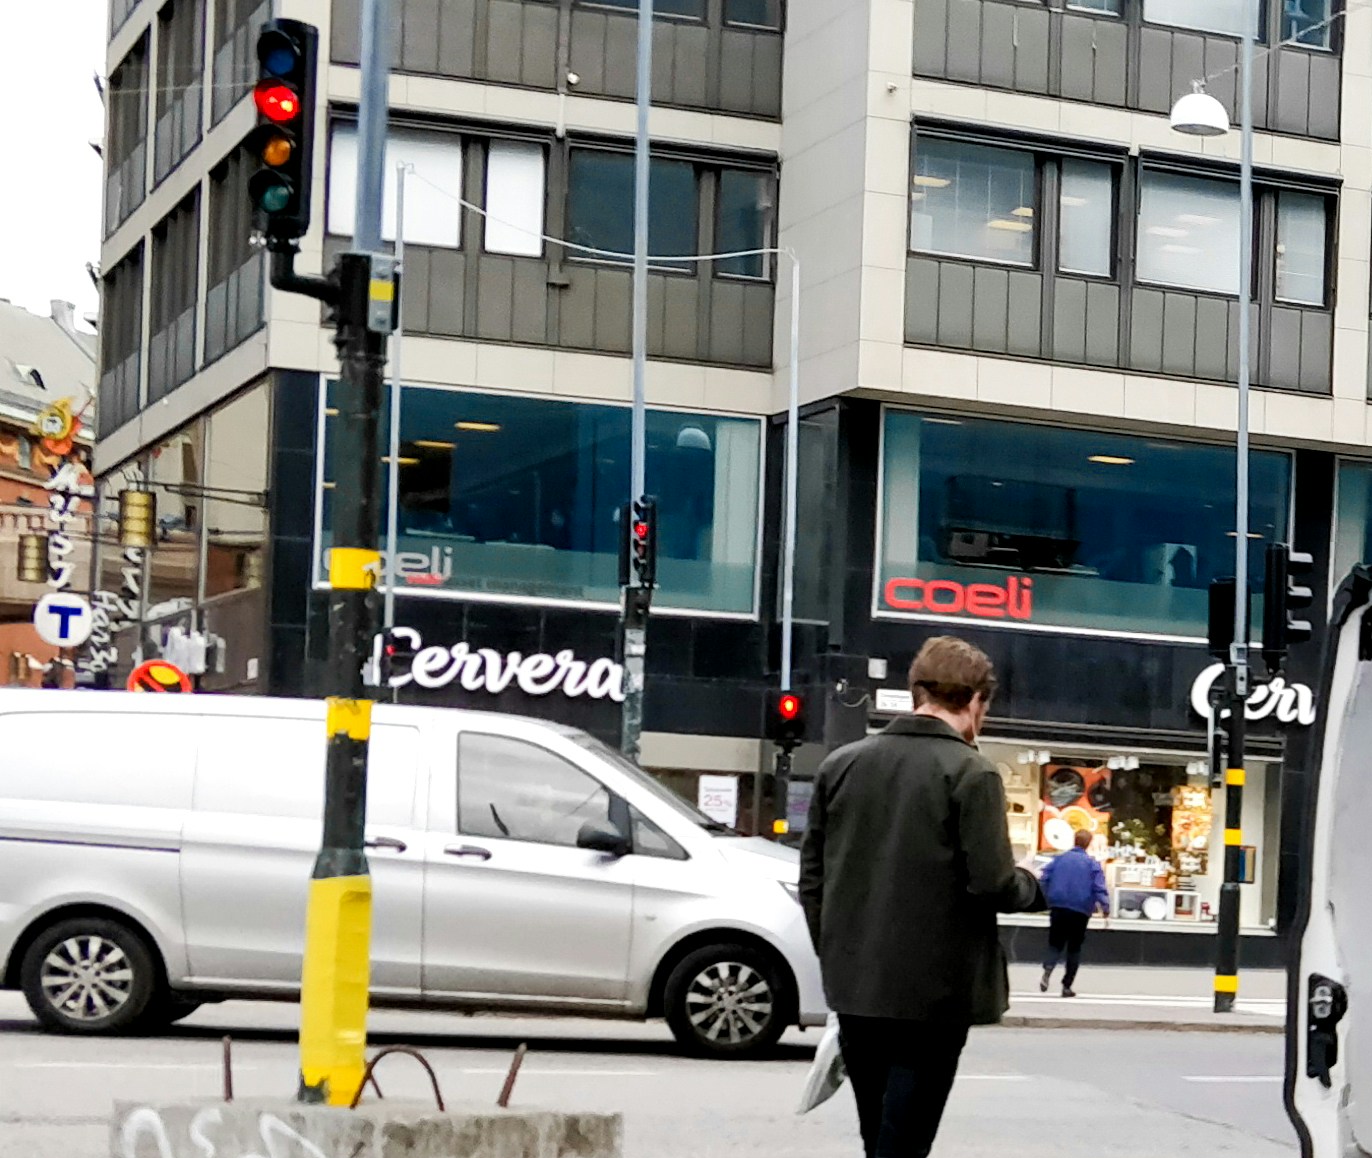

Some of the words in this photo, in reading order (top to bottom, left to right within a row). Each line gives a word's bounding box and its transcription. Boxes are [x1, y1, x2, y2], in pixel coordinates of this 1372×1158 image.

[323, 545, 454, 584] eli
[884, 575, 1033, 620] coeli
[48, 605, 83, 639] T
[372, 626, 626, 702] Cervera
